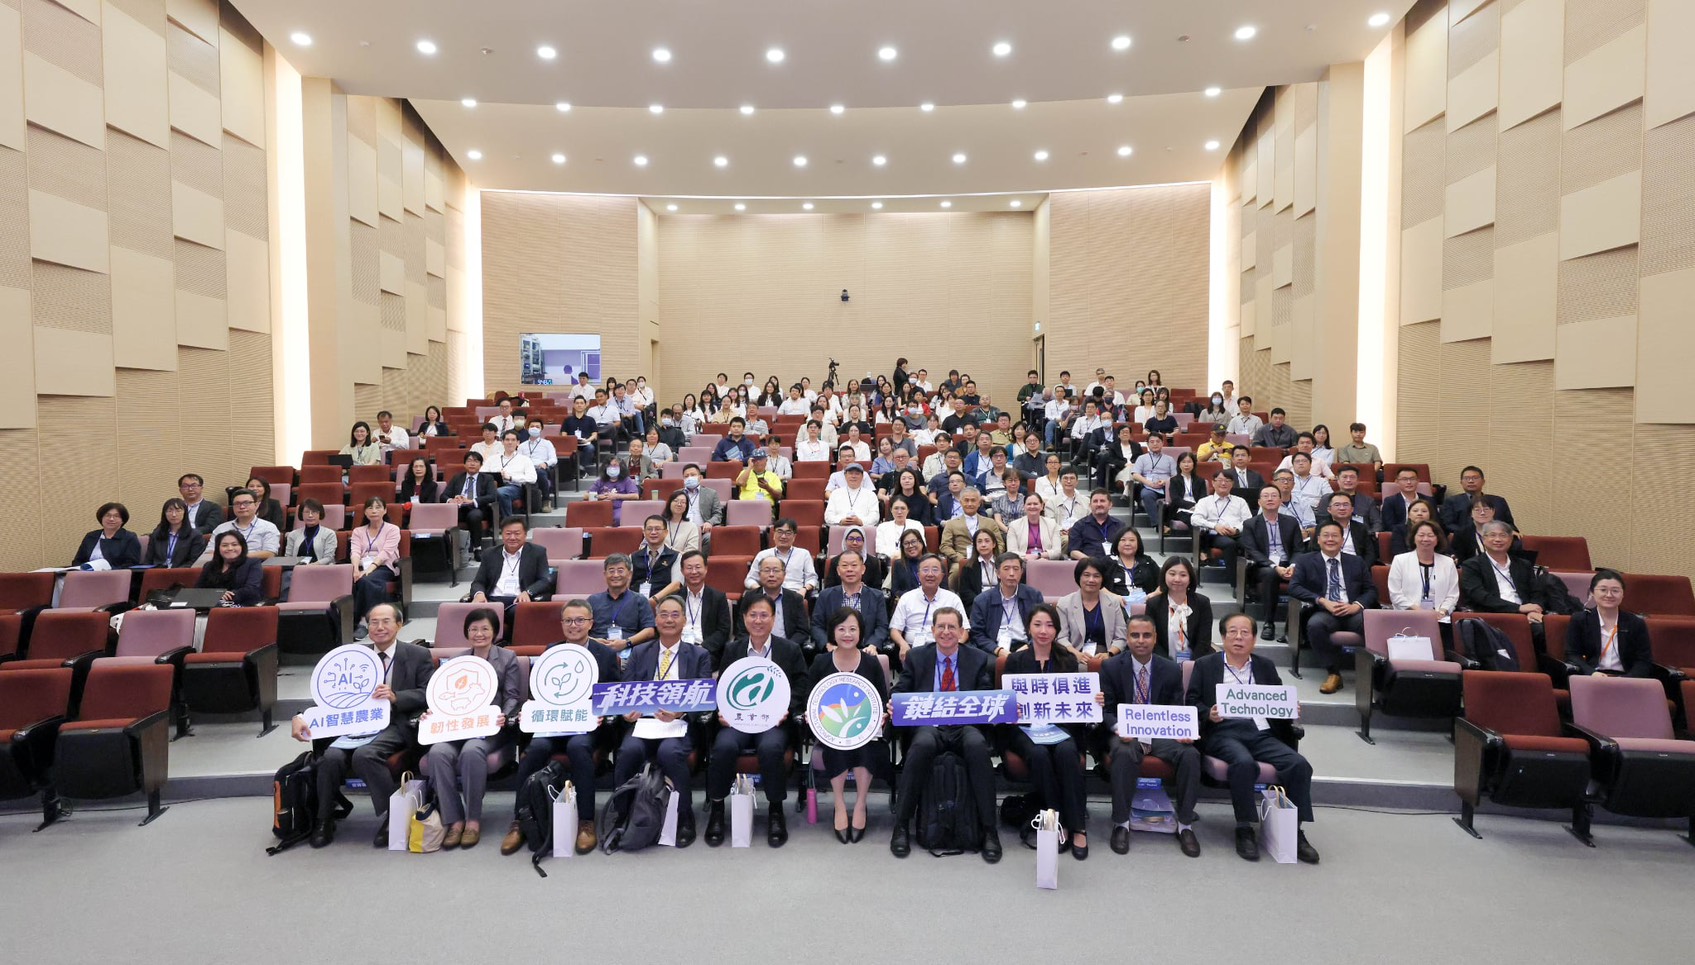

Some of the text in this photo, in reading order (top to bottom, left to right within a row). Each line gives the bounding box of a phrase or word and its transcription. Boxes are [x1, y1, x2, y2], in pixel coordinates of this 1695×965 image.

[338, 672, 352, 686] AI
[1011, 677, 1091, 695] 與時俱進
[594, 680, 715, 715] 科技領航
[812, 679, 838, 705] TECHNOLOGY
[839, 676, 867, 690] RESEARCH
[866, 688, 879, 714] INSTITUTE
[1226, 689, 1288, 702] Advanced
[531, 709, 588, 722] 循環賦能
[901, 694, 1010, 722] 鏈結全球
[1125, 708, 1191, 722] Relentless
[1221, 702, 1293, 718] Technology
[309, 707, 384, 729] AI智慧農業
[431, 715, 489, 734] 韌性發展
[1126, 724, 1192, 738] Innovation
